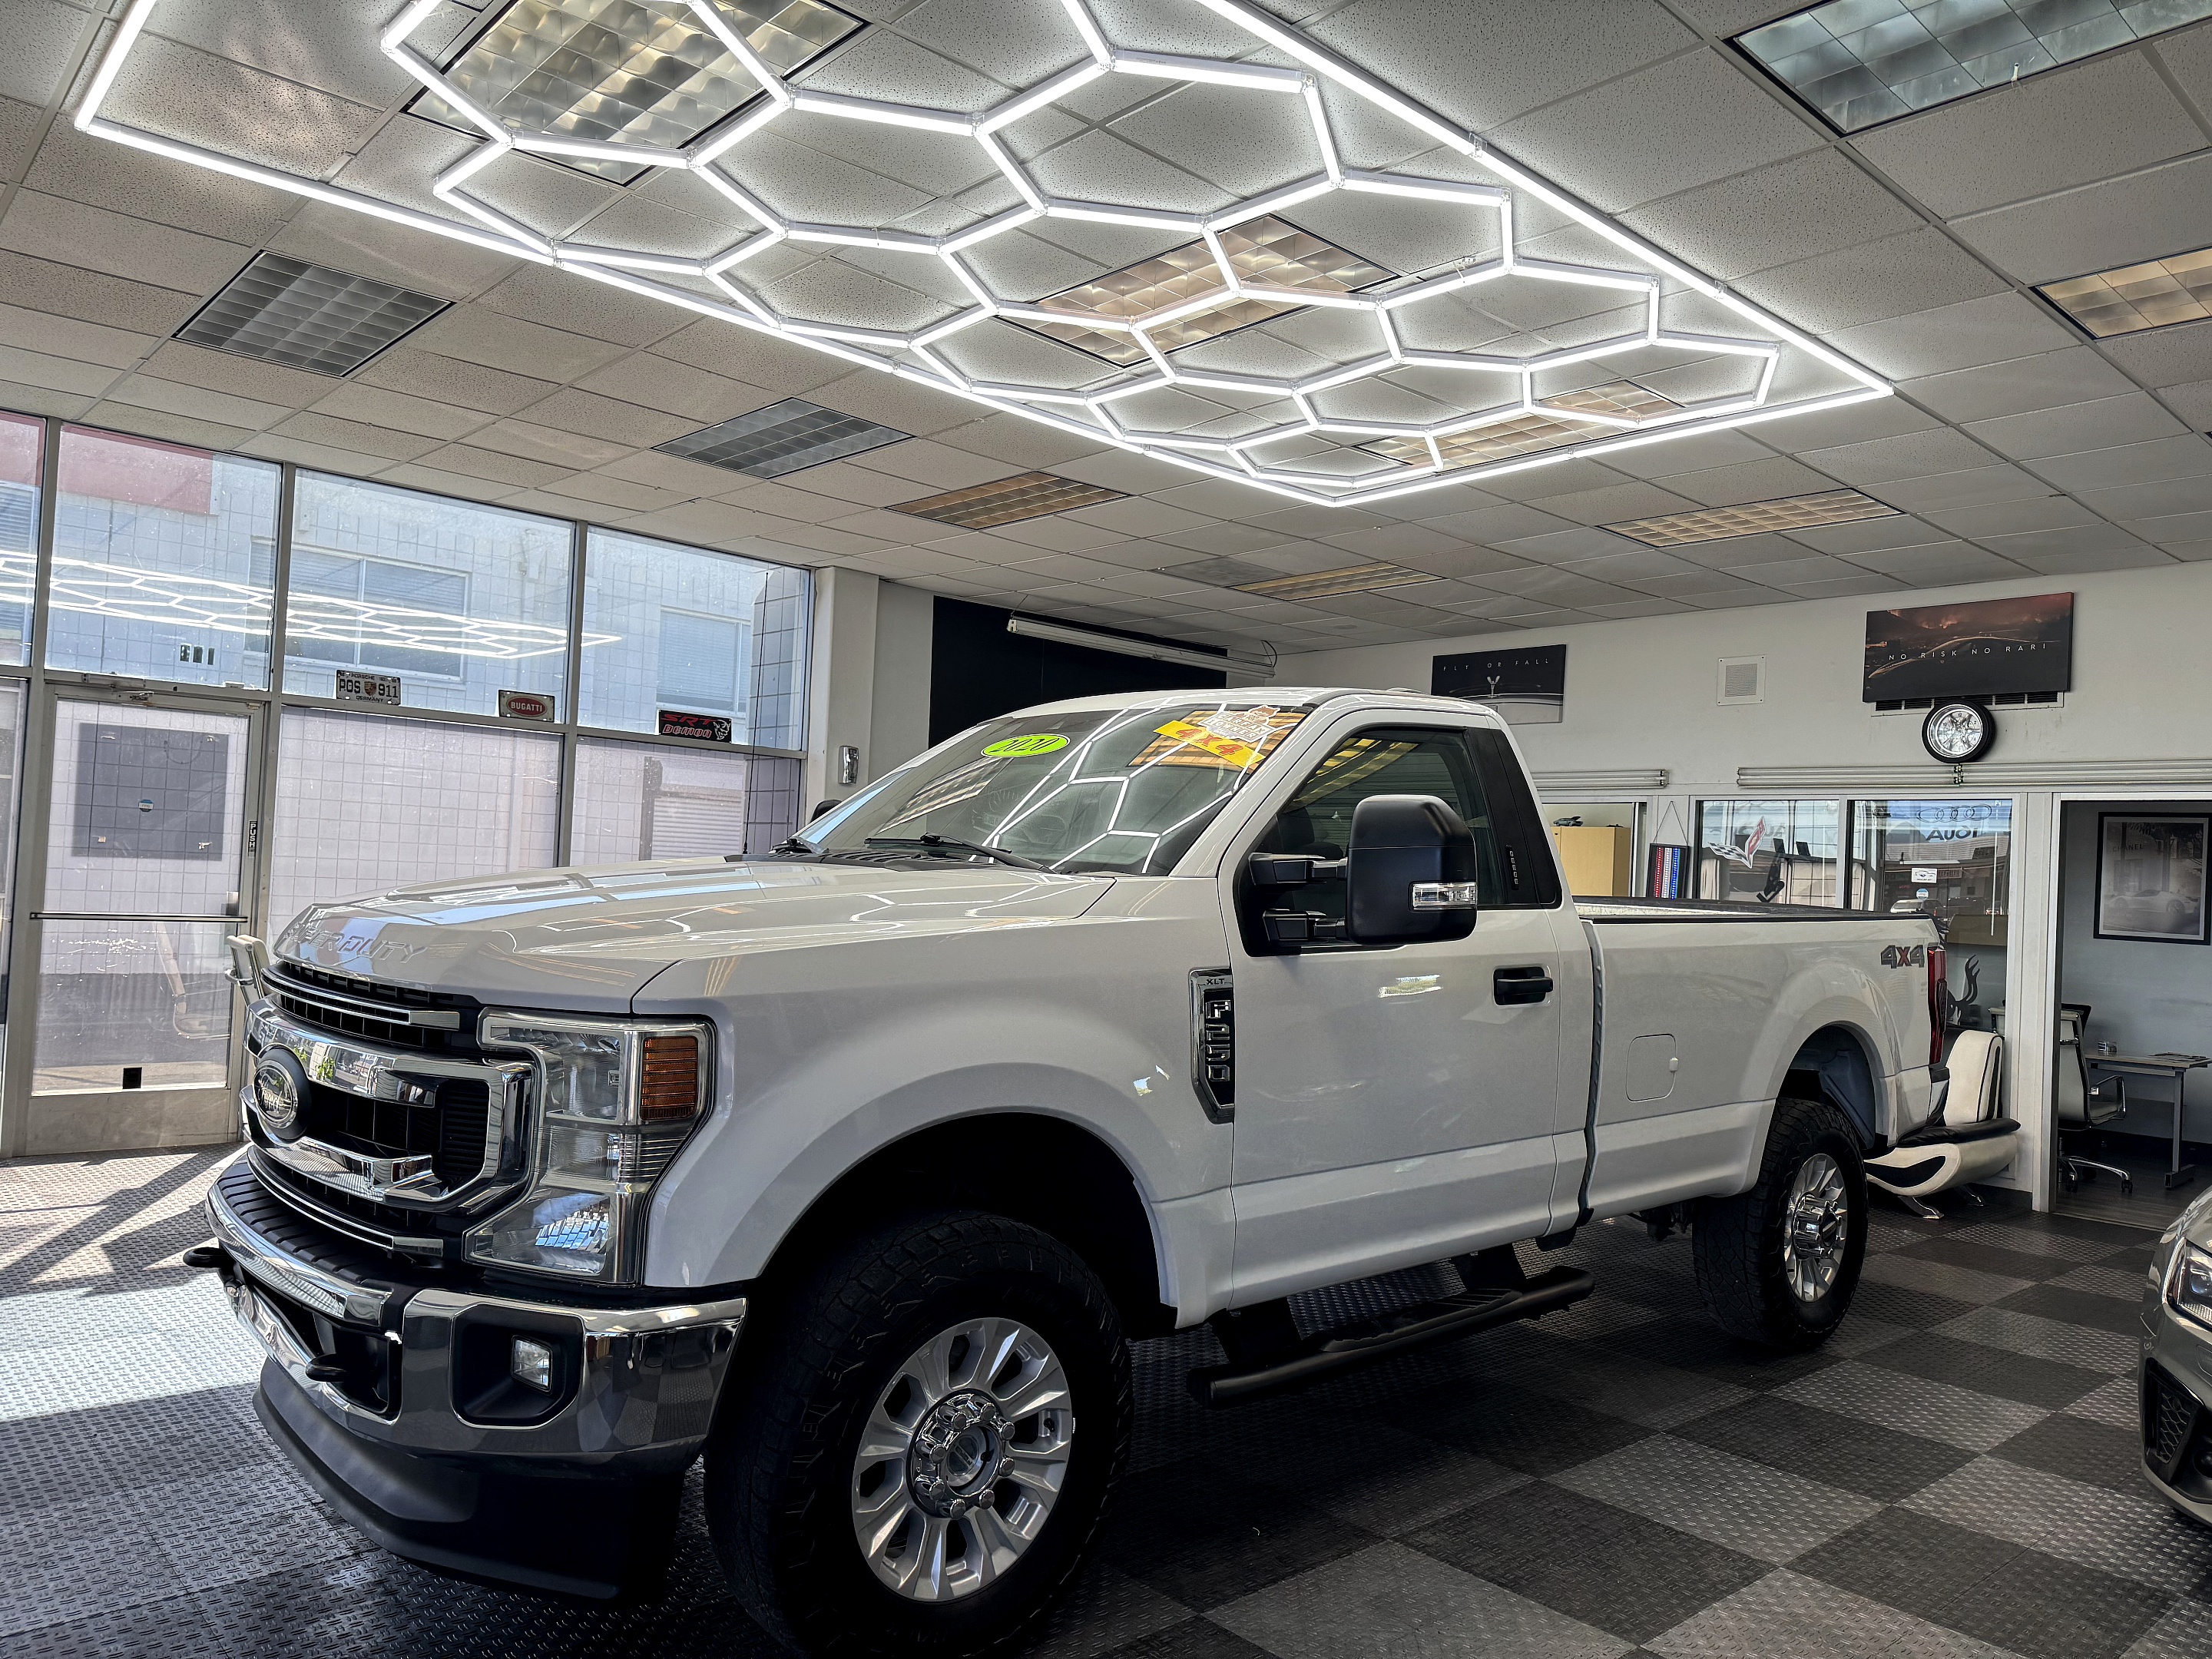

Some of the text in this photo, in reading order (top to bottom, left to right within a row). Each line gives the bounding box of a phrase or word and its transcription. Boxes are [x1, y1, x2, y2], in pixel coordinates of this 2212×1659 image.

[1921, 650, 1957, 658] RISK
[2005, 643, 2045, 653] RARI
[378, 683, 399, 698] 911
[511, 701, 542, 712] BUGATTI
[661, 714, 717, 727] SRT
[1217, 714, 1267, 735] CARFAX
[336, 935, 429, 964] DUTY
